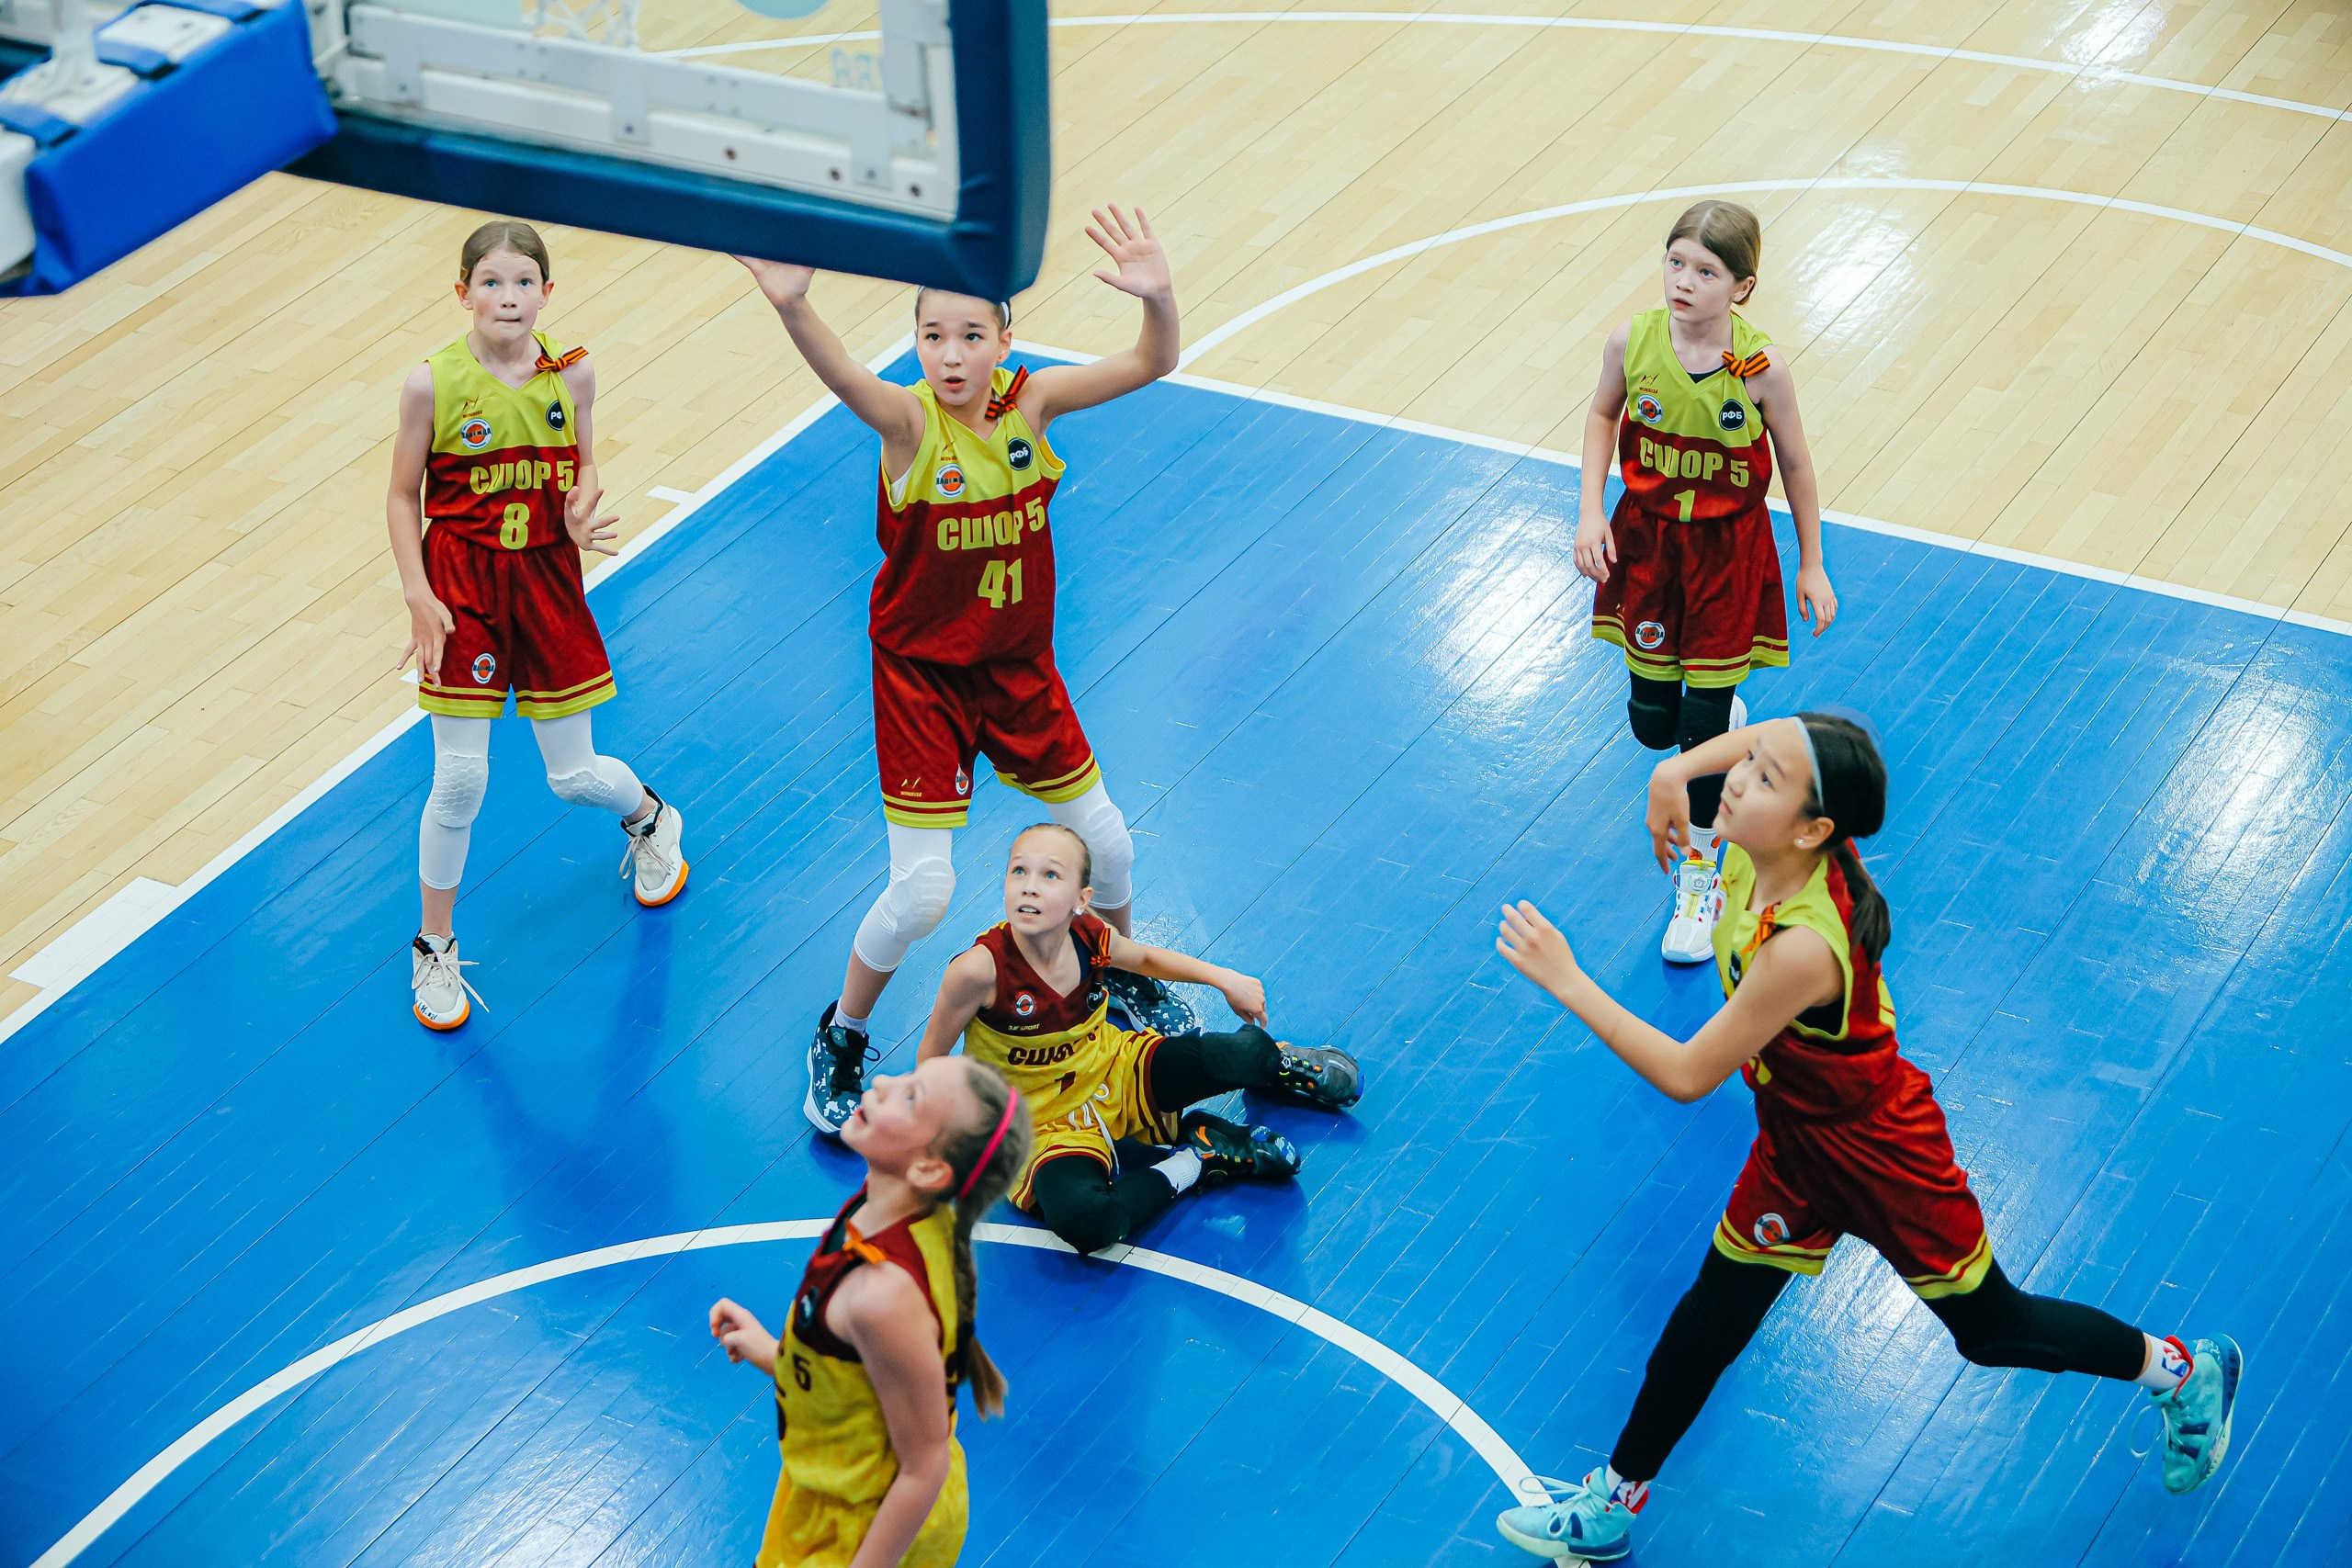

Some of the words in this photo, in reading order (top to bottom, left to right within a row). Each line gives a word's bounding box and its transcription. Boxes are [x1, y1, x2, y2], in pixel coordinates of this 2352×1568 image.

[1722, 411, 1743, 421] РФБ
[469, 459, 551, 495] СШОР
[556, 460, 574, 492] 5
[1639, 436, 1724, 481] СШОР
[1730, 459, 1749, 488] 5
[499, 502, 530, 550] 8
[937, 511, 1023, 551] СШОР
[1025, 497, 1046, 532] 5
[1673, 490, 1696, 522] 1
[978, 558, 1023, 608] 41
